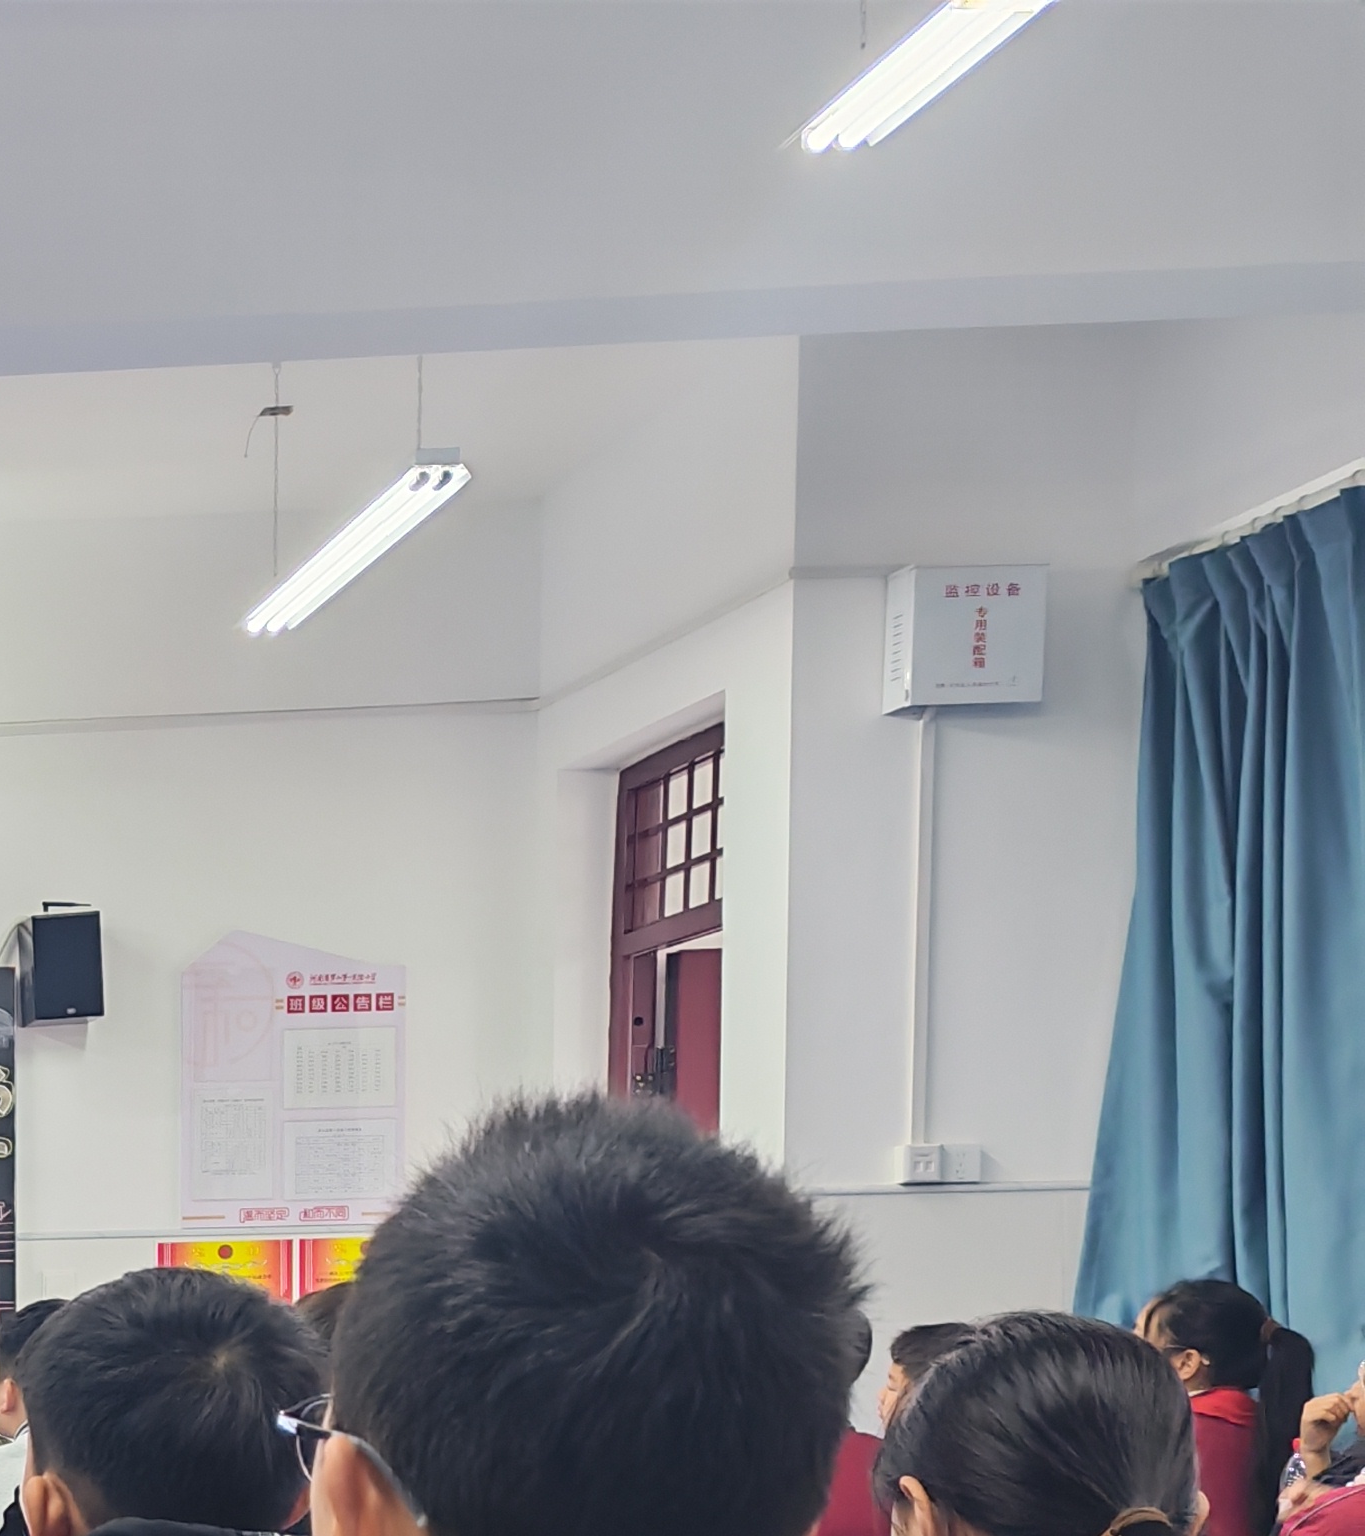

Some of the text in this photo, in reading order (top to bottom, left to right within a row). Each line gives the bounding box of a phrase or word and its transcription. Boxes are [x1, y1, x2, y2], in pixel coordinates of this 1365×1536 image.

[944, 582, 1021, 598] 监控设备
[287, 993, 394, 1013] 班级公告栏
